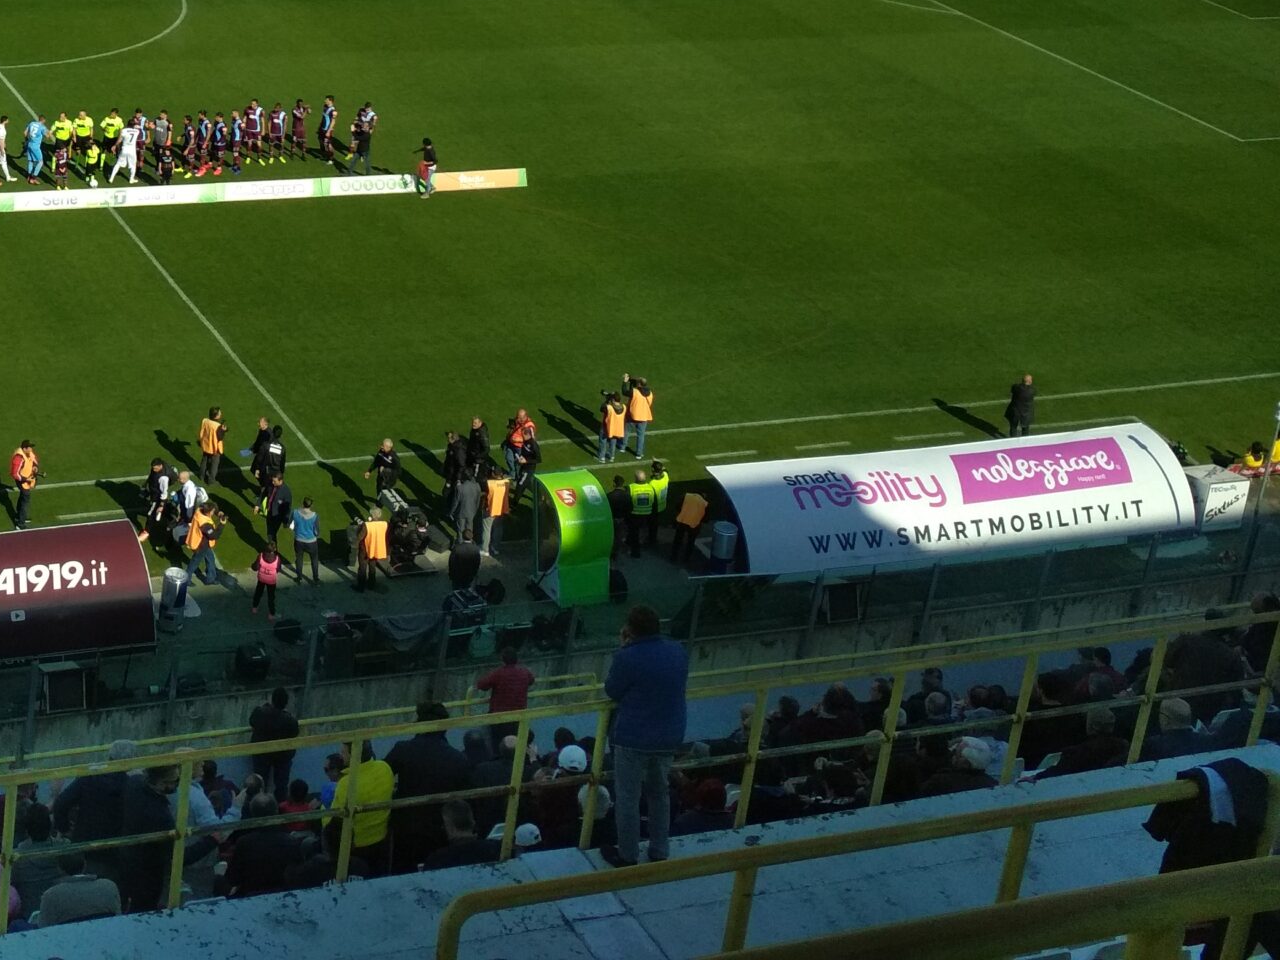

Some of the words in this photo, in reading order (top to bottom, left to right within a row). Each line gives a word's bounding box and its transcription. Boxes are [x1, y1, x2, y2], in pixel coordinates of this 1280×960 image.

[783, 470, 839, 487] smart
[792, 470, 947, 510] mobility
[808, 499, 1144, 555] WWW.SMARTMOBILITY.IT
